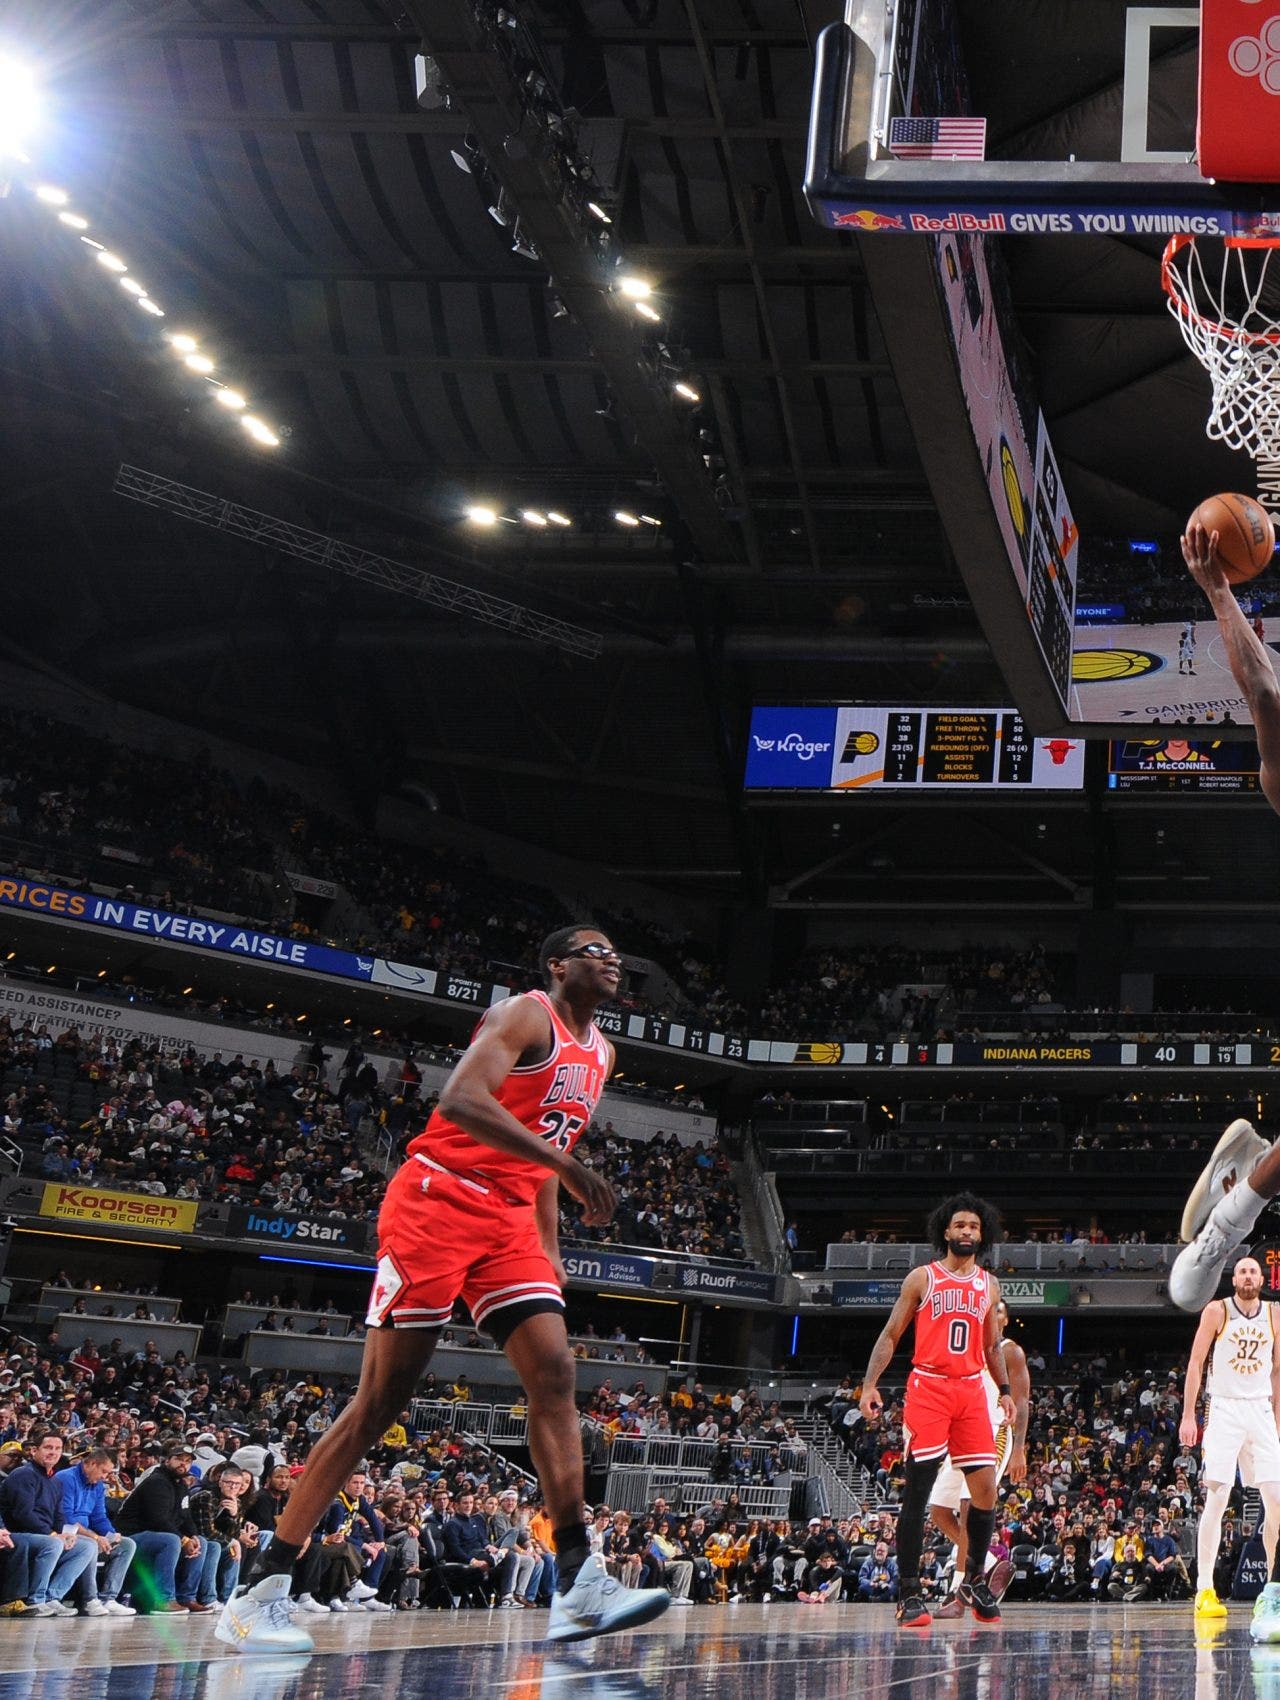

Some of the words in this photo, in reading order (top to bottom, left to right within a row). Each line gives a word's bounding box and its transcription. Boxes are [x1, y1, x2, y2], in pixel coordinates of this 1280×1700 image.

[1010, 213, 1073, 233] GIVES
[1078, 214, 1126, 234] YOU
[900, 715, 910, 723] 32
[938, 715, 959, 723] FIELD
[959, 715, 979, 723] GOAL
[777, 733, 831, 761] Kroger
[944, 763, 973, 771] BLOCKS
[1138, 762, 1155, 770] T.J.
[1156, 762, 1217, 770] McCONNELL
[936, 773, 980, 781] TURNOVERS
[0, 881, 86, 916] RICES
[94, 901, 124, 924] IN
[133, 909, 226, 945] EVERY
[230, 932, 308, 964] AISLE
[447, 984, 478, 1001] 8/21
[0, 989, 25, 1003] EED
[26, 994, 122, 1021] ASSISTANCE?
[593, 1016, 622, 1032] 4/43
[690, 1036, 703, 1049] 11
[728, 1045, 743, 1057] 23
[875, 1051, 884, 1062] 4
[918, 1051, 928, 1063] 3
[983, 1048, 1038, 1060] INDIANA
[1040, 1048, 1092, 1060] PACERS
[1154, 1047, 1176, 1062] 40
[1217, 1053, 1231, 1063] 19
[538, 1109, 585, 1153] 25
[57, 1188, 178, 1219] Koorsen
[56, 1206, 85, 1217] FIRE
[91, 1211, 102, 1219] &
[109, 1212, 176, 1227] SECURITY
[609, 1263, 629, 1273] CPAs
[608, 1271, 641, 1283] Advisors
[700, 1273, 737, 1289] Ruoff
[932, 1289, 990, 1324] BULLS
[948, 1319, 970, 1354] 0
[1228, 1325, 1268, 1347] INDIANA
[1236, 1339, 1259, 1361] 32
